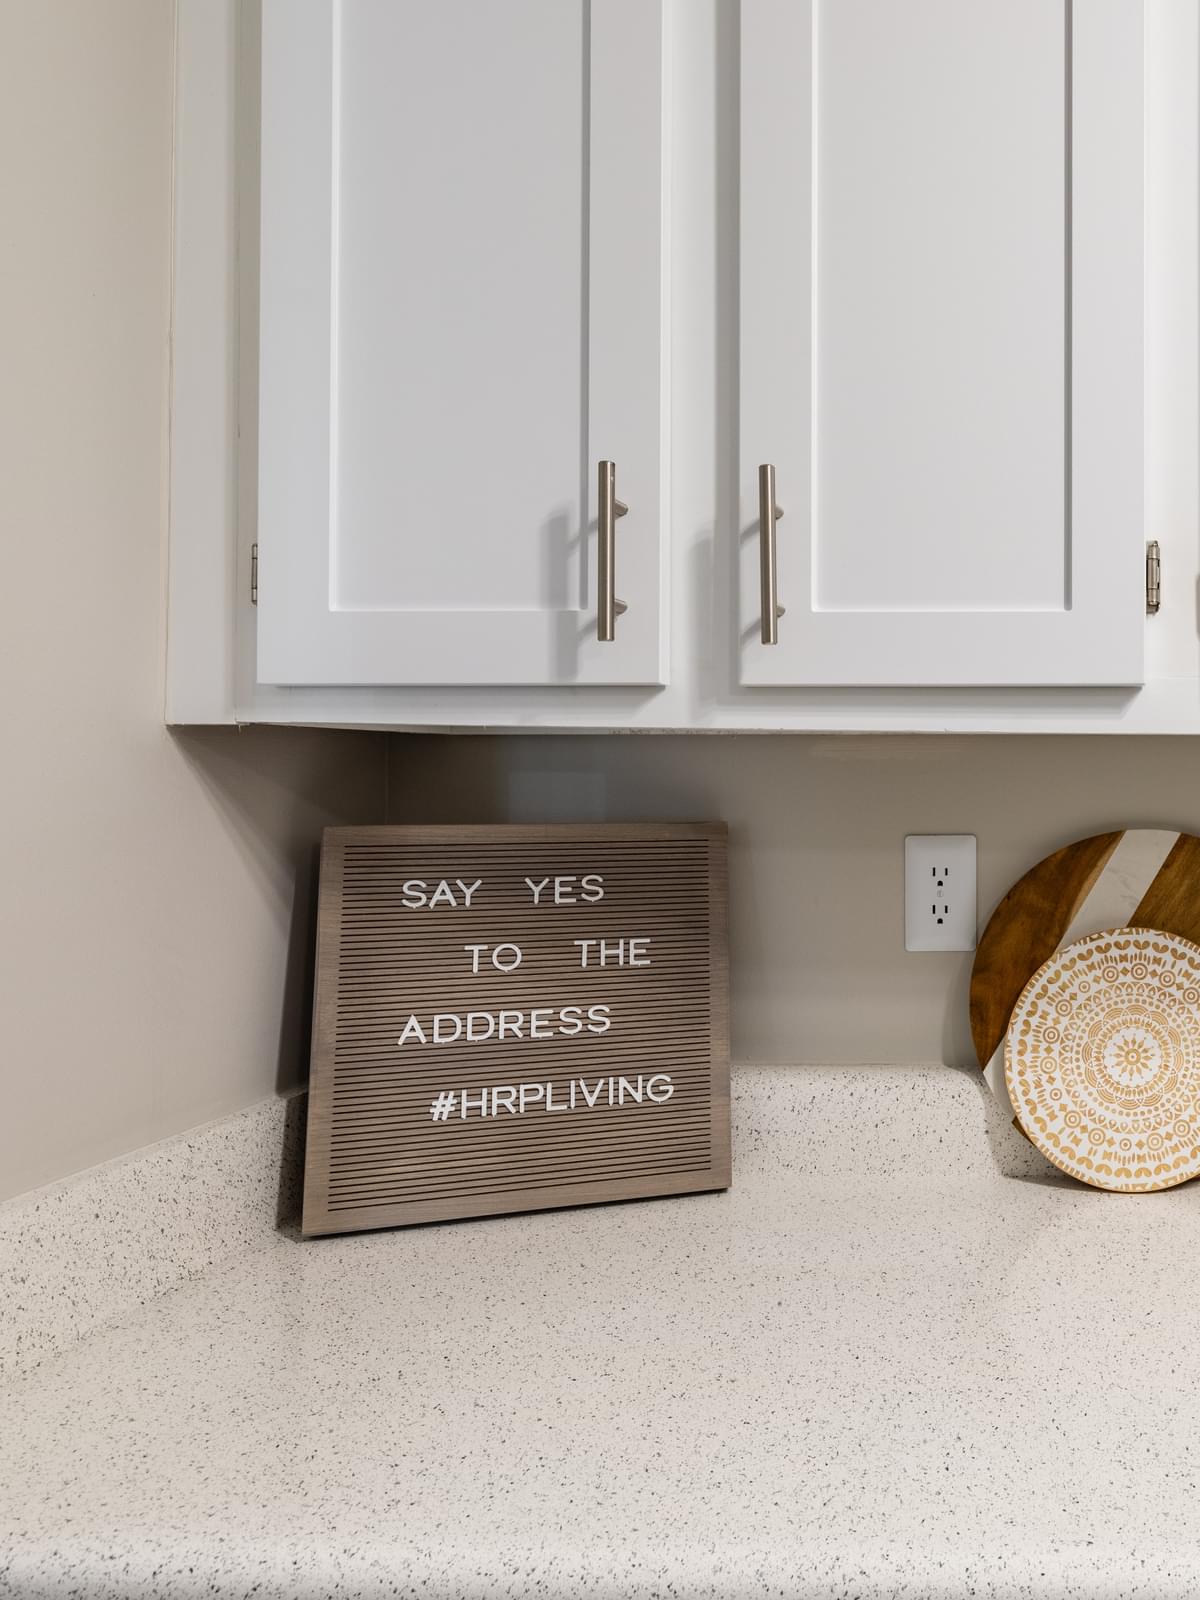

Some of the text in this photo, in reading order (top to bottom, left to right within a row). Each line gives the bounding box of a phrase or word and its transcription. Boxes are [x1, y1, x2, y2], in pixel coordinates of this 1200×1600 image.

[402, 875, 604, 909] SAY YES
[464, 938, 651, 974] TO THE
[398, 1004, 612, 1046] ADDRESS
[429, 1074, 675, 1121] #HRPLIVING
